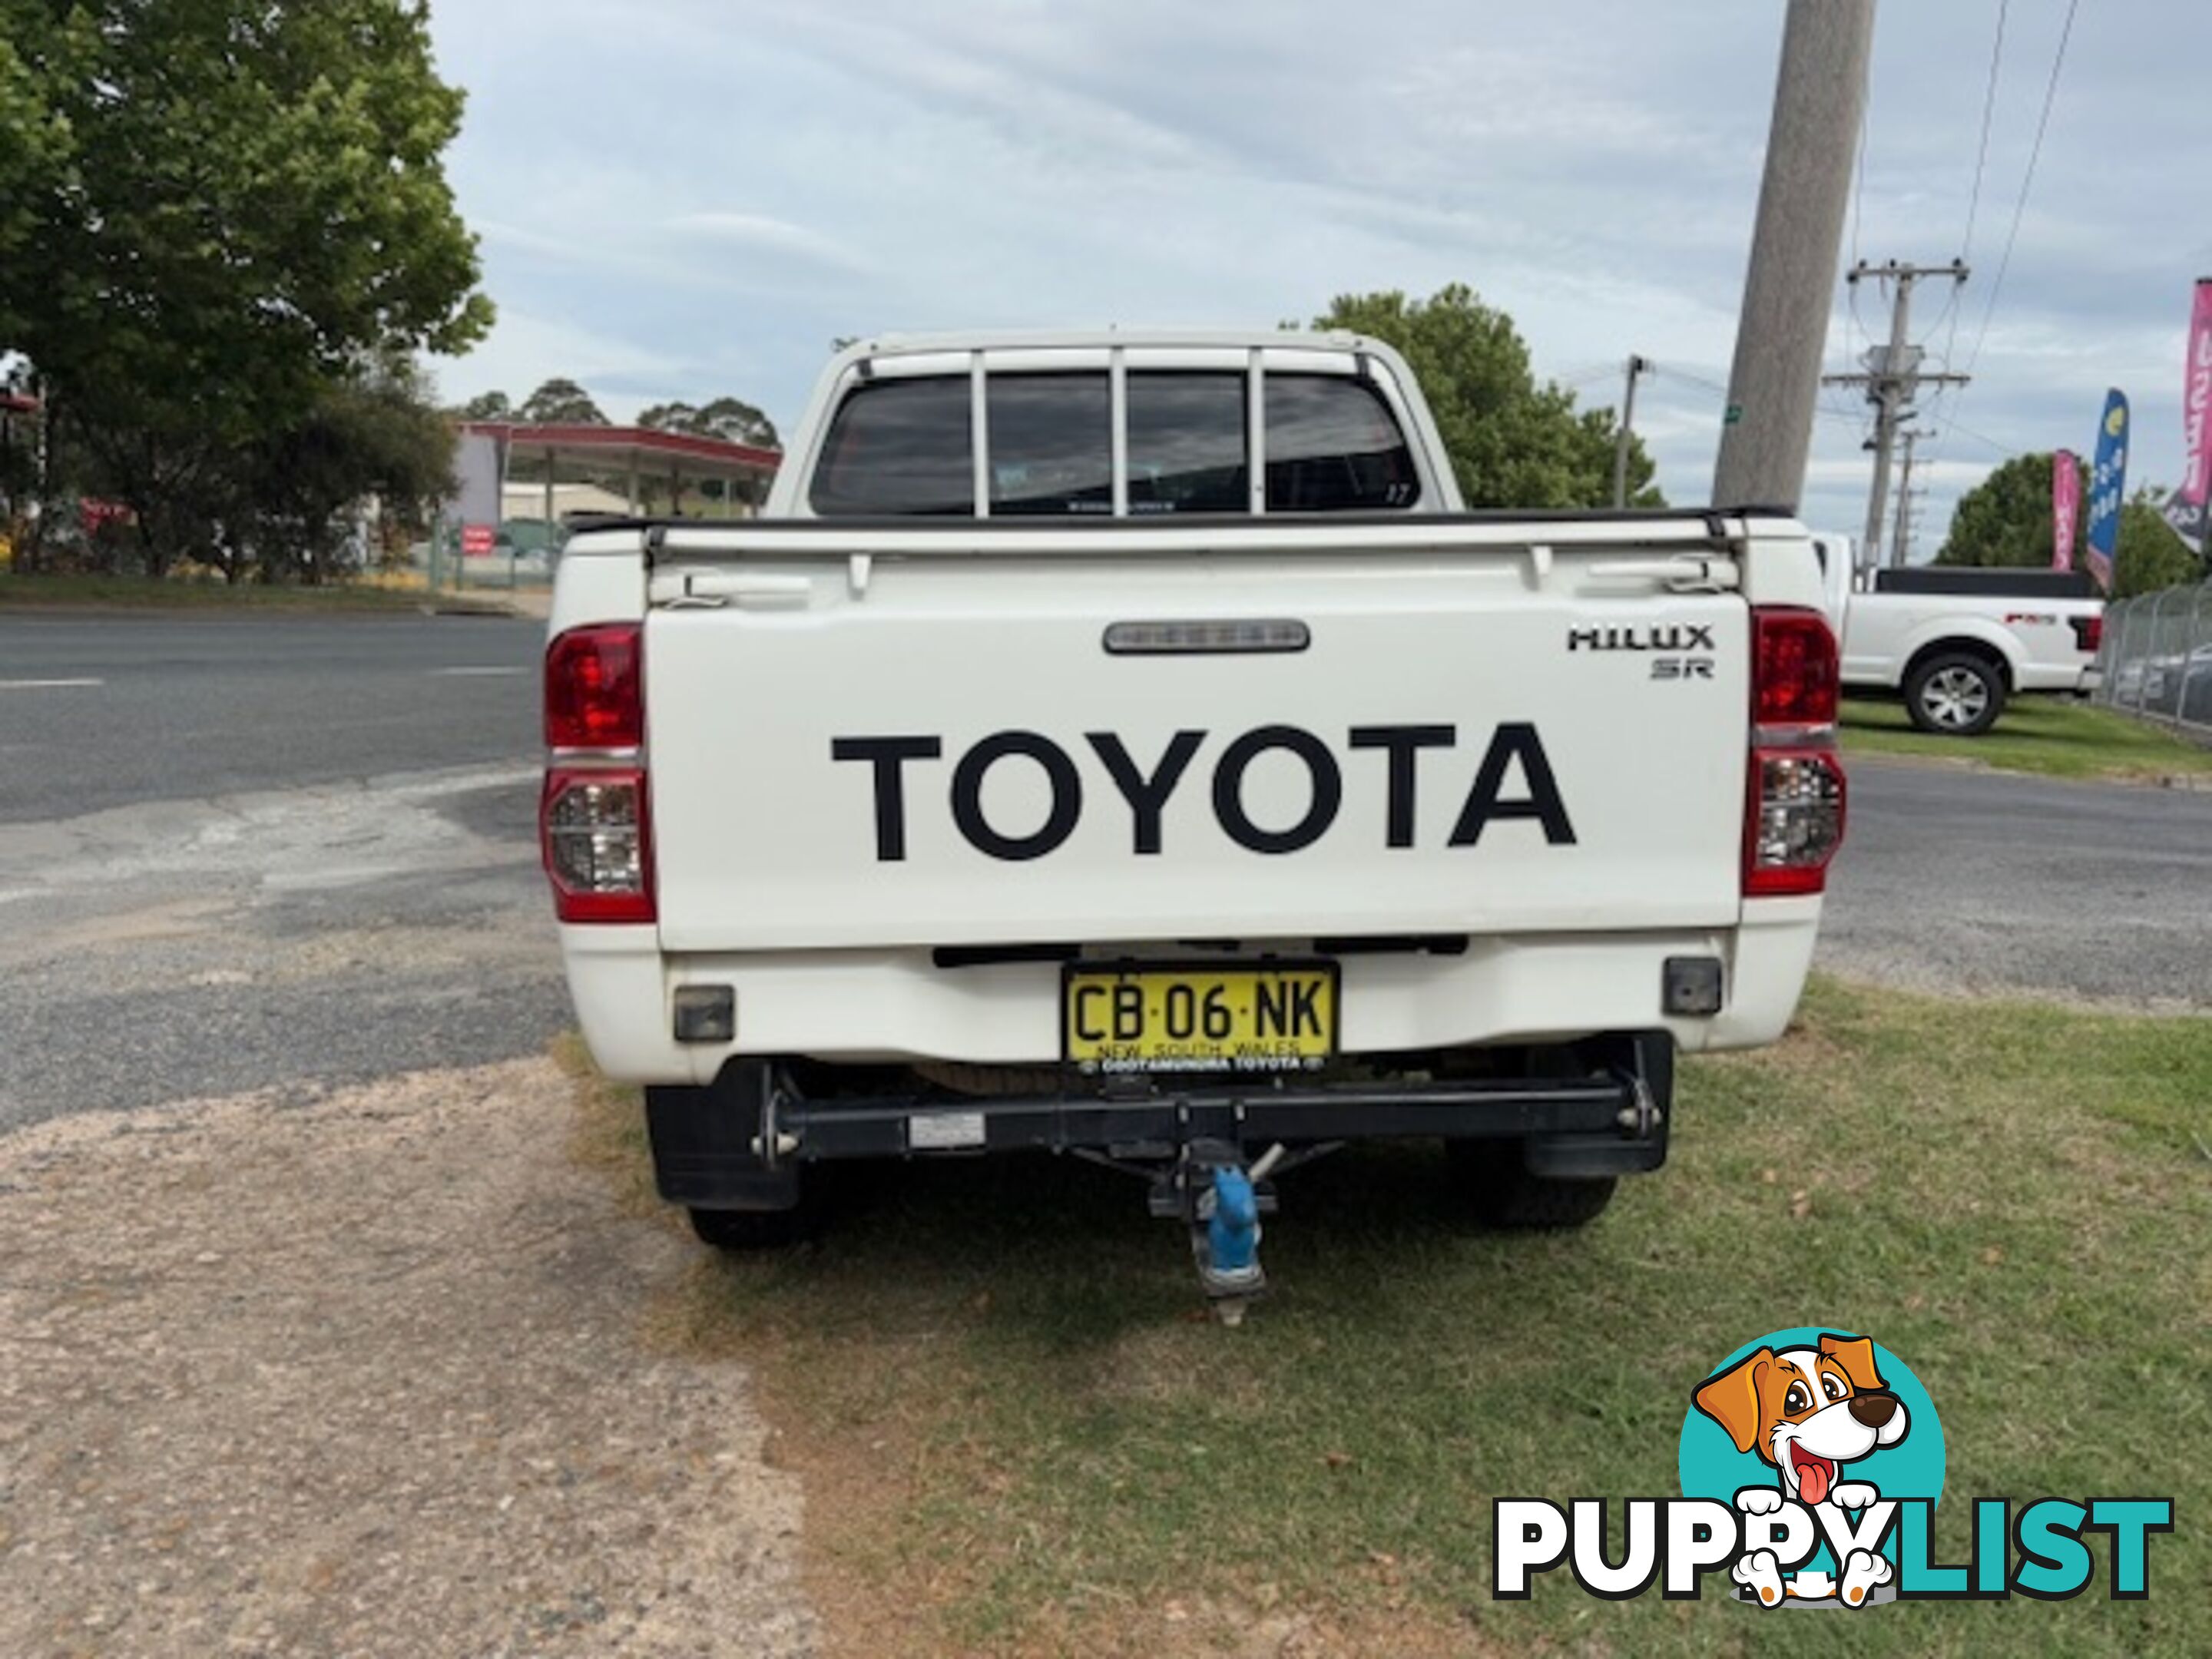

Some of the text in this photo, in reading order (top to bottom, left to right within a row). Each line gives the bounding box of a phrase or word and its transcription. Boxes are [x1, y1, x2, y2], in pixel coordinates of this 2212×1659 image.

[1568, 624, 1716, 651] HILUX
[1650, 657, 1715, 680] SR
[831, 722, 1578, 861] TOYOTA
[1097, 1040, 1300, 1059] NEW SOUTH WALES
[1234, 1056, 1300, 1071] TOYOTA
